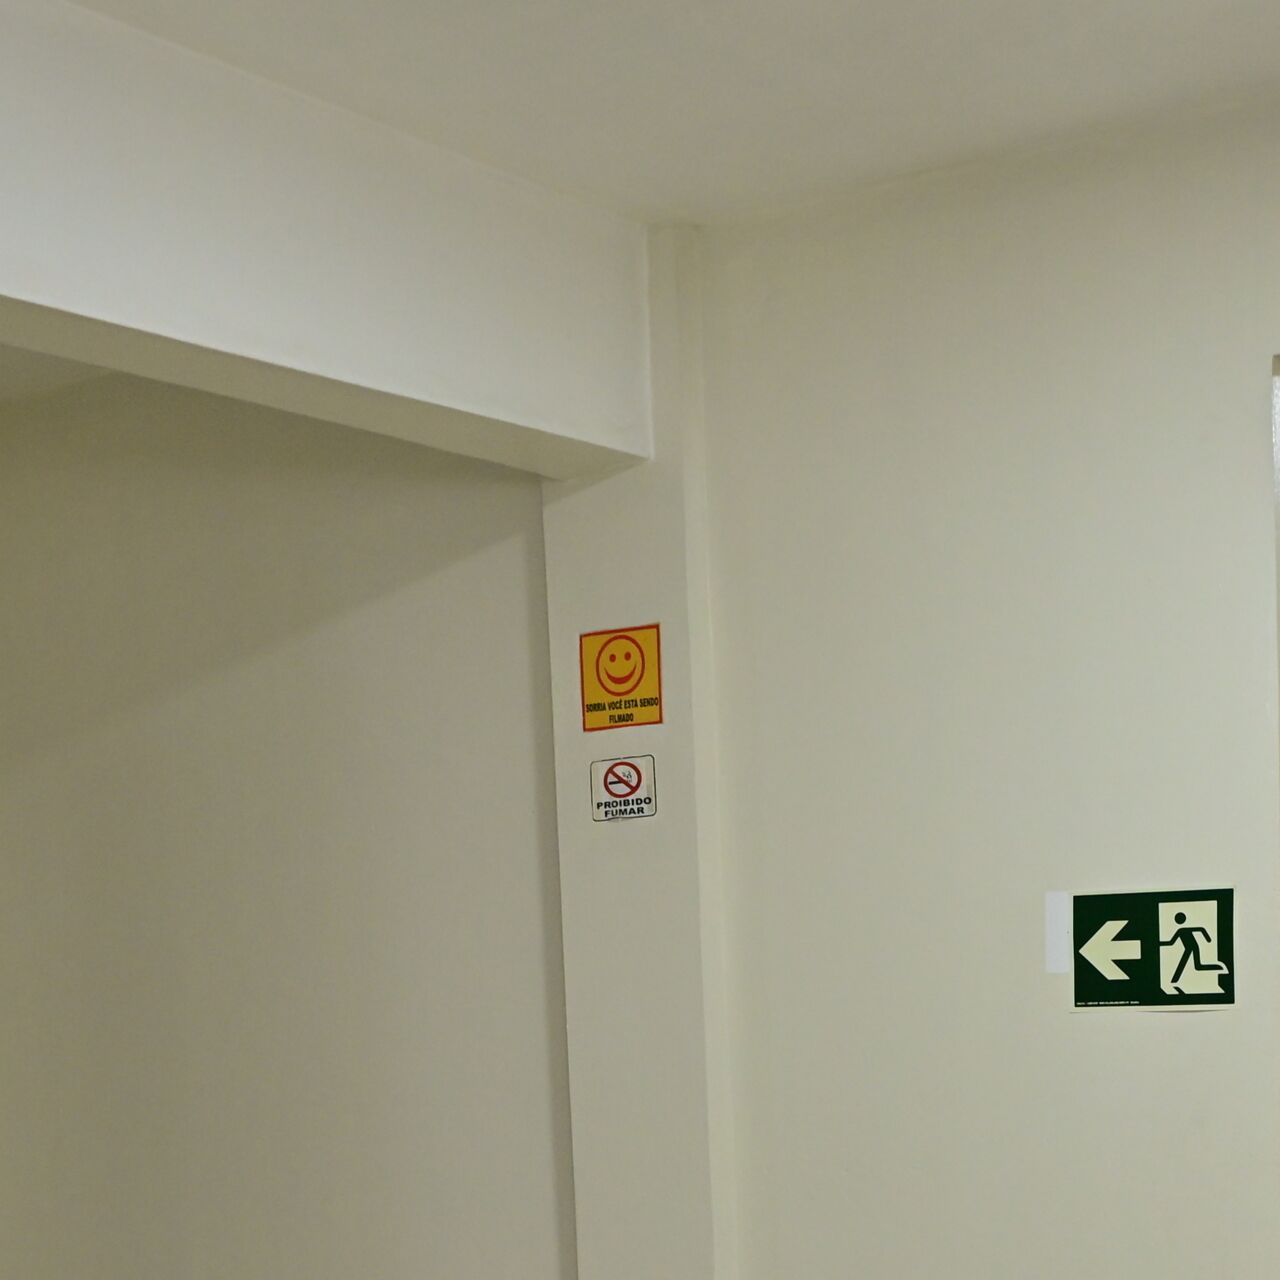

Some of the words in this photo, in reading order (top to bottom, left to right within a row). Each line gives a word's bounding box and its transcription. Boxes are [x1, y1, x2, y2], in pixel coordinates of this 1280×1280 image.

[586, 702, 606, 713] SORRIA
[640, 697, 659, 707] SENDO
[609, 713, 634, 723] FILMADO
[596, 797, 652, 810] PROIBIDO
[604, 806, 645, 818] FUMAR
